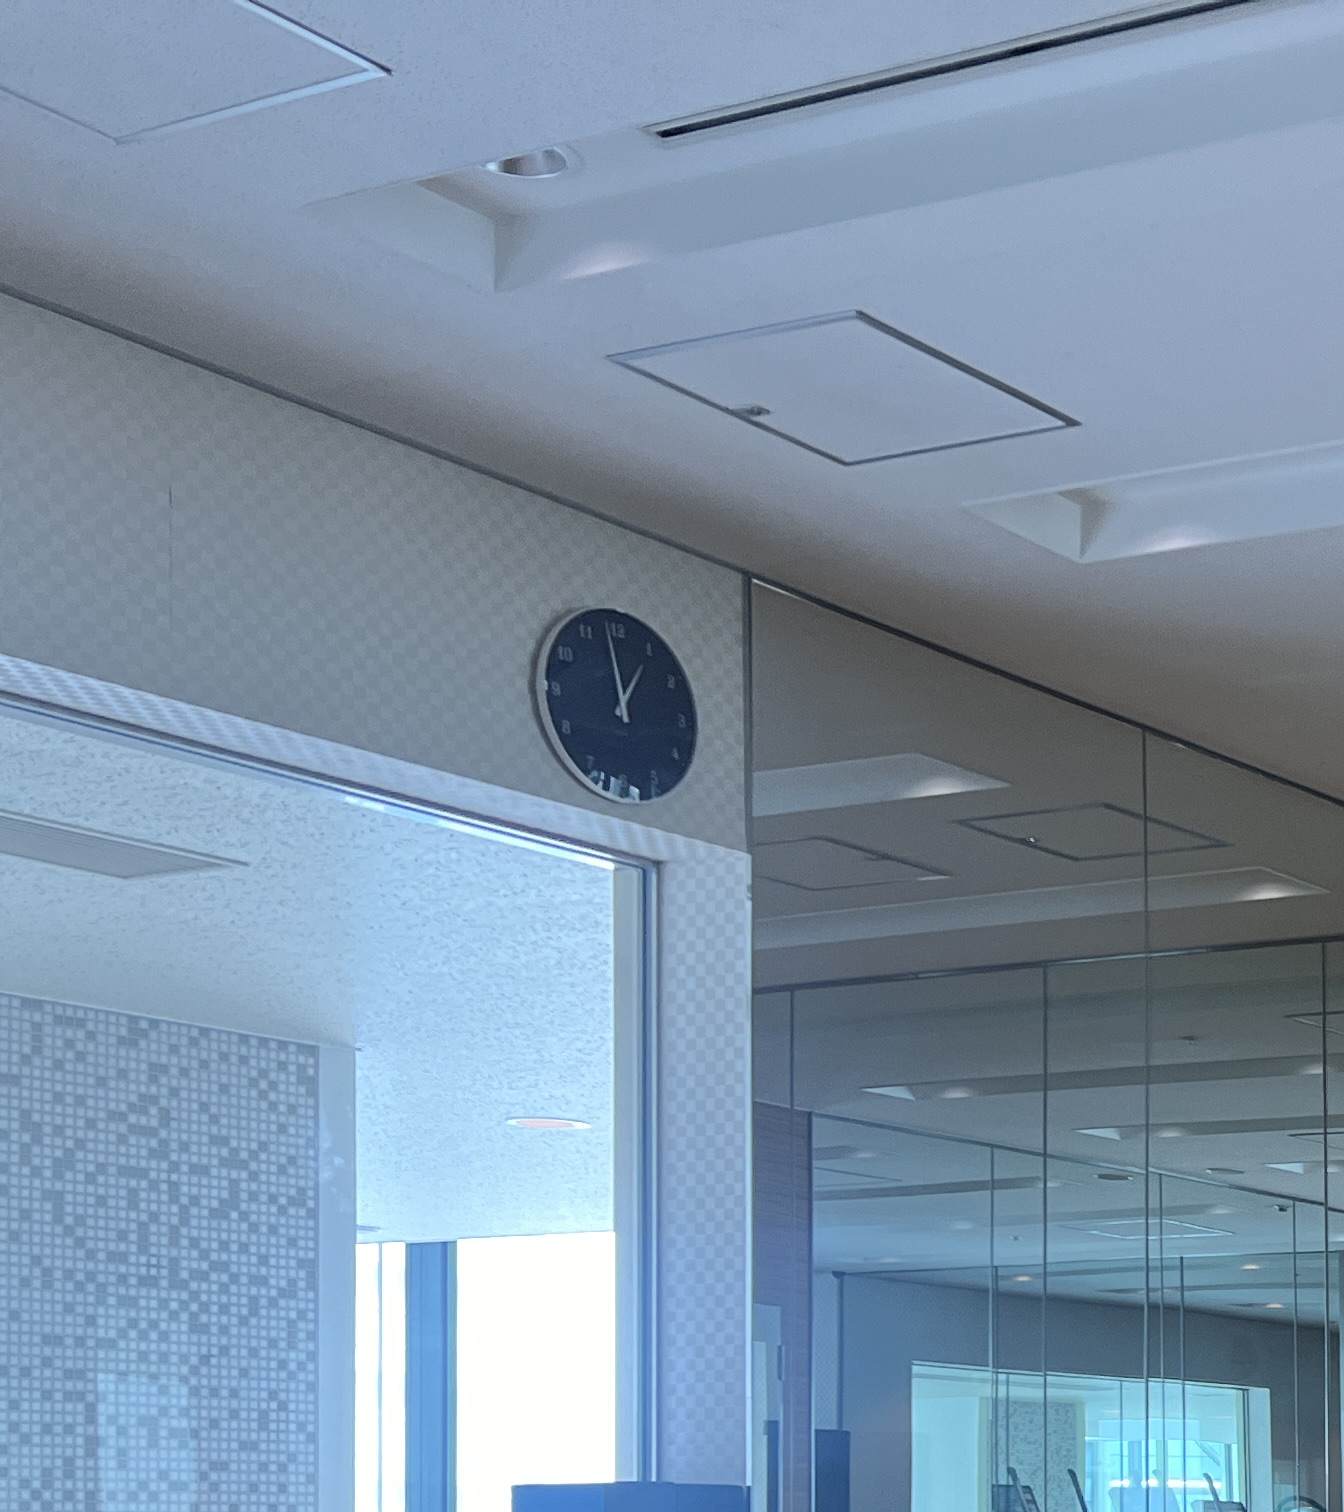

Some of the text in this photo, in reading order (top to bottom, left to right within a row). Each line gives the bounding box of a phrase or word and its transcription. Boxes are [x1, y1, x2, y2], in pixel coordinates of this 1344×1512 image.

[579, 624, 593, 640] 11
[558, 645, 574, 663] 10
[645, 641, 653, 657] 1
[551, 681, 561, 697] 9
[667, 675, 676, 689] 2
[562, 719, 571, 735] 8
[678, 713, 687, 729] 3
[586, 755, 596, 769] 7
